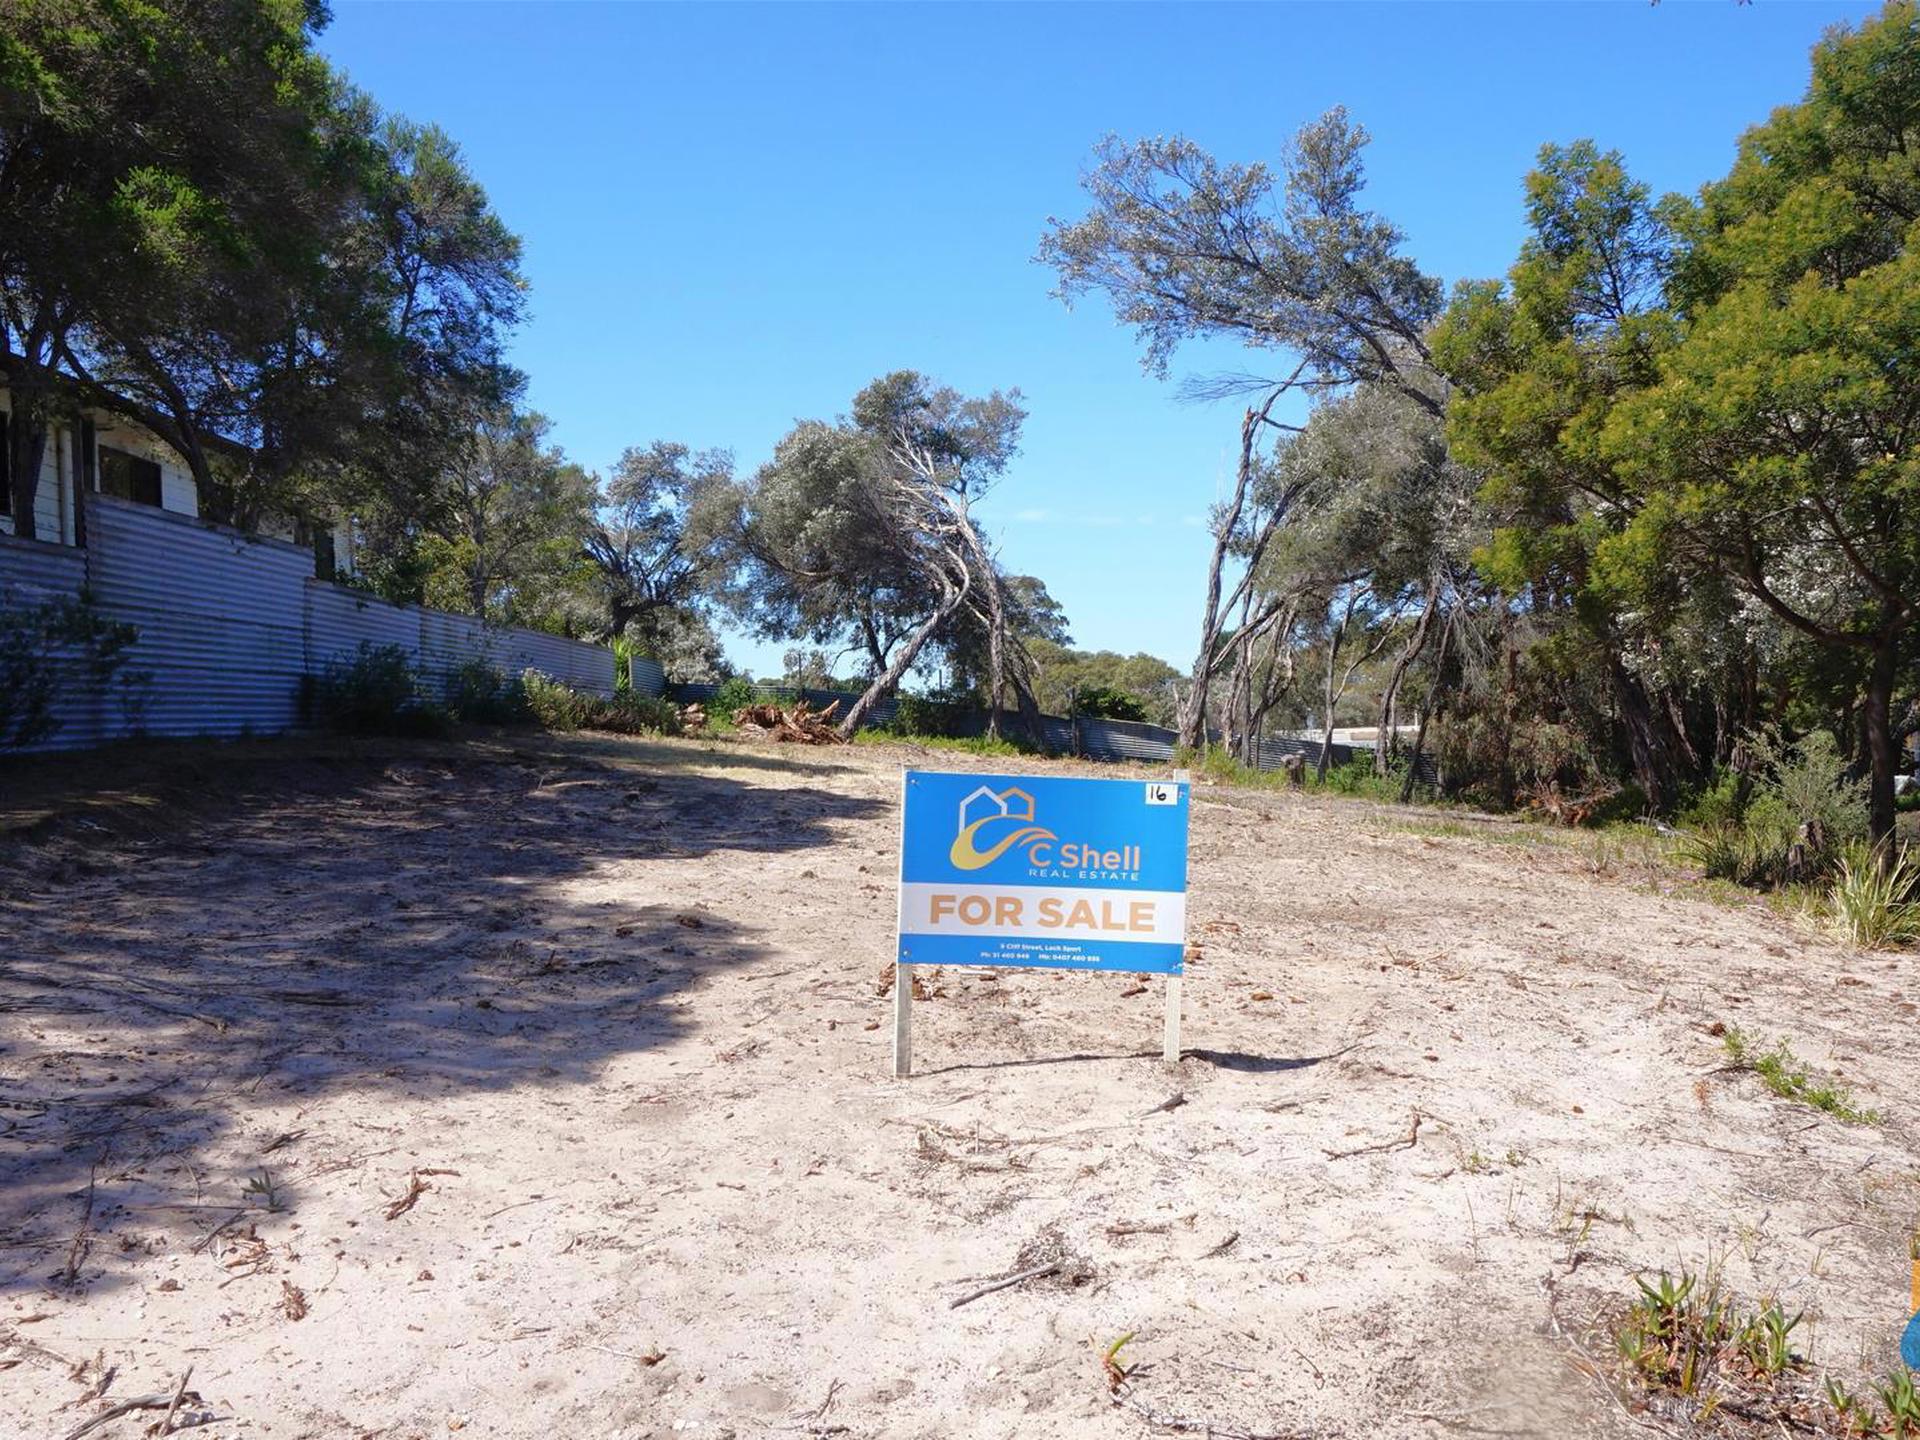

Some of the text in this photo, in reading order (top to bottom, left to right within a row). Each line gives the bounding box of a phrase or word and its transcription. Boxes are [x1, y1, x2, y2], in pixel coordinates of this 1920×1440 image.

[1150, 785, 1167, 802] 16
[1030, 843, 1141, 871] C Shell
[1028, 868, 1140, 881] REAL ESTATE
[930, 895, 1155, 931] FOR SALE
